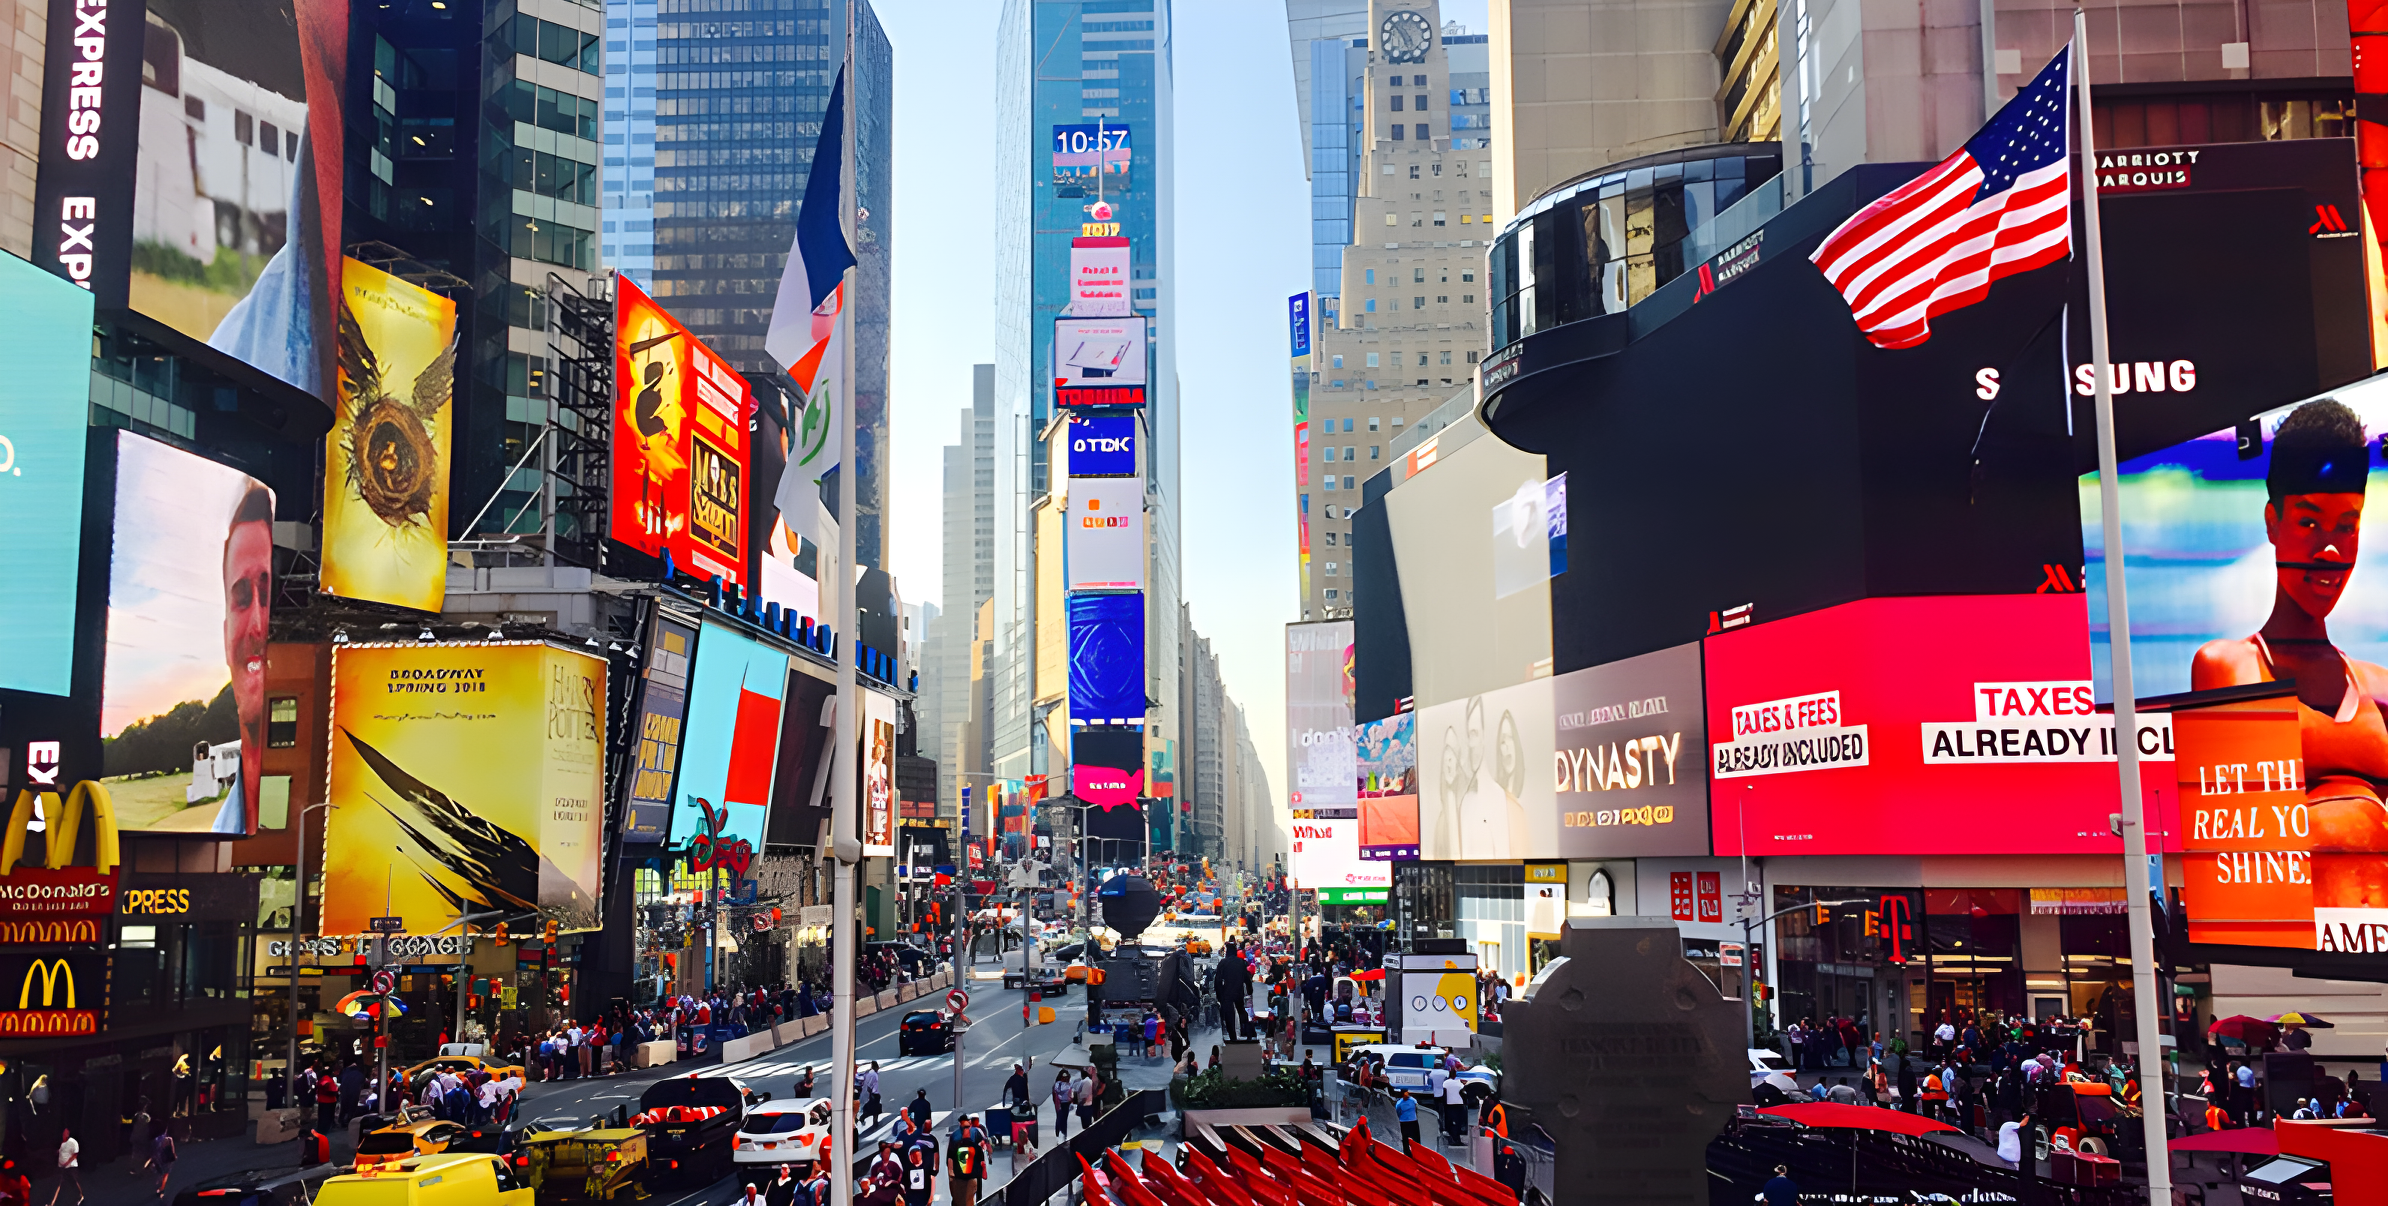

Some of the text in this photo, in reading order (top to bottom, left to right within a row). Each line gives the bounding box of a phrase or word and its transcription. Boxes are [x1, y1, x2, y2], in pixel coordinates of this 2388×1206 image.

[1058, 130, 1128, 153] 10:57
[2095, 170, 2187, 187] ARQUIS
[59, 197, 95, 291] EXP
[1975, 359, 2196, 401] SSUNG
[1798, 697, 1838, 729] FEES
[1980, 686, 2095, 717] TAXES
[1932, 725, 2175, 758] ALREADY ICL
[1555, 731, 1681, 793] DYNASTY
[2200, 759, 2305, 796] LET TH
[2193, 805, 2264, 840] REAL
